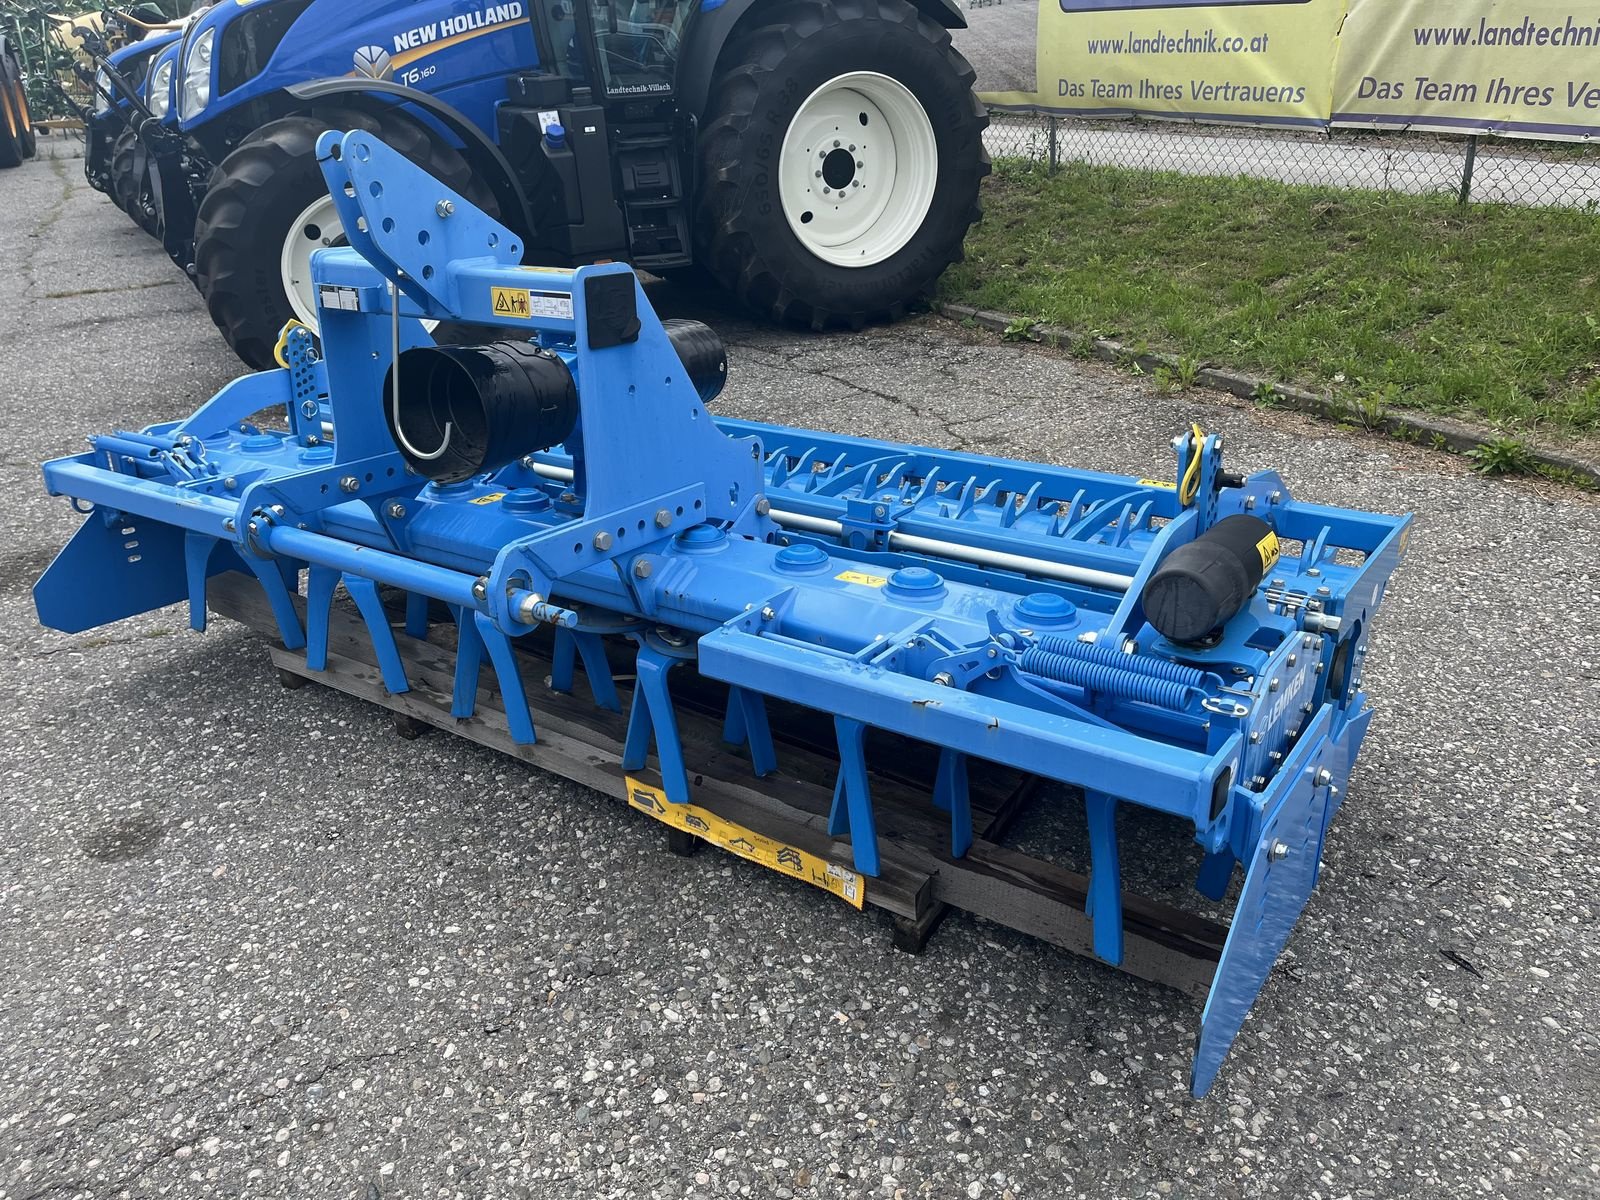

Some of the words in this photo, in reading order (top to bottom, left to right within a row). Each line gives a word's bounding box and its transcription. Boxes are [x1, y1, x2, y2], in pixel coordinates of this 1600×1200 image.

[393, 23, 437, 52] NEW
[440, 1, 523, 38] HOLLAND
[1088, 29, 1269, 55] www.landtechnik.co.at
[606, 83, 671, 95] Landtechnik-Villach
[1058, 78, 1085, 97] Das
[1090, 78, 1133, 99] Team
[1139, 78, 1183, 100] Ihres
[1190, 79, 1306, 104] Vertrauens
[1357, 76, 1404, 100] Das
[1414, 77, 1477, 103] Team
[1485, 77, 1555, 106] Ihres
